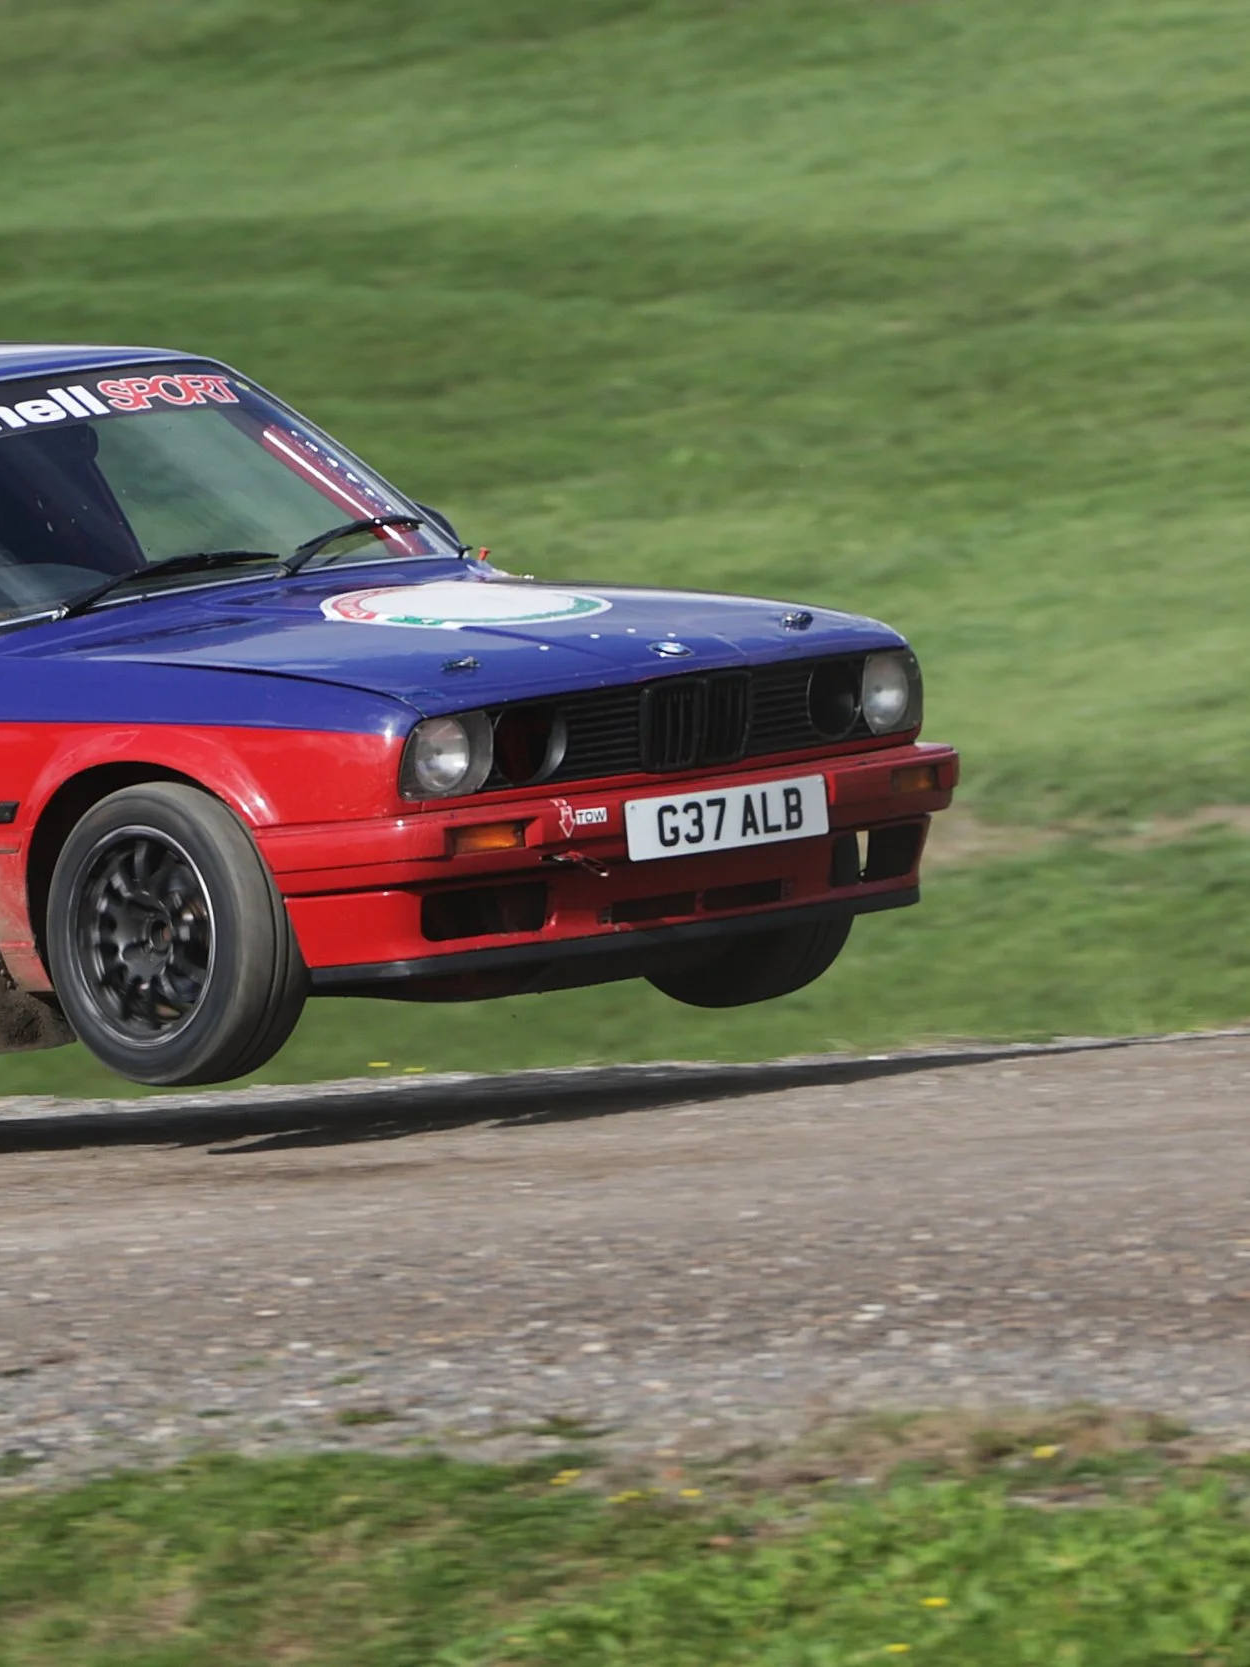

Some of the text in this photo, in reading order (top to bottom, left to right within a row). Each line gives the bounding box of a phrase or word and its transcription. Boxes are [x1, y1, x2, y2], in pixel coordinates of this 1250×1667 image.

[97, 374, 240, 411] SPORT
[577, 810, 606, 823] TOW
[657, 786, 804, 848] G37 ALB
